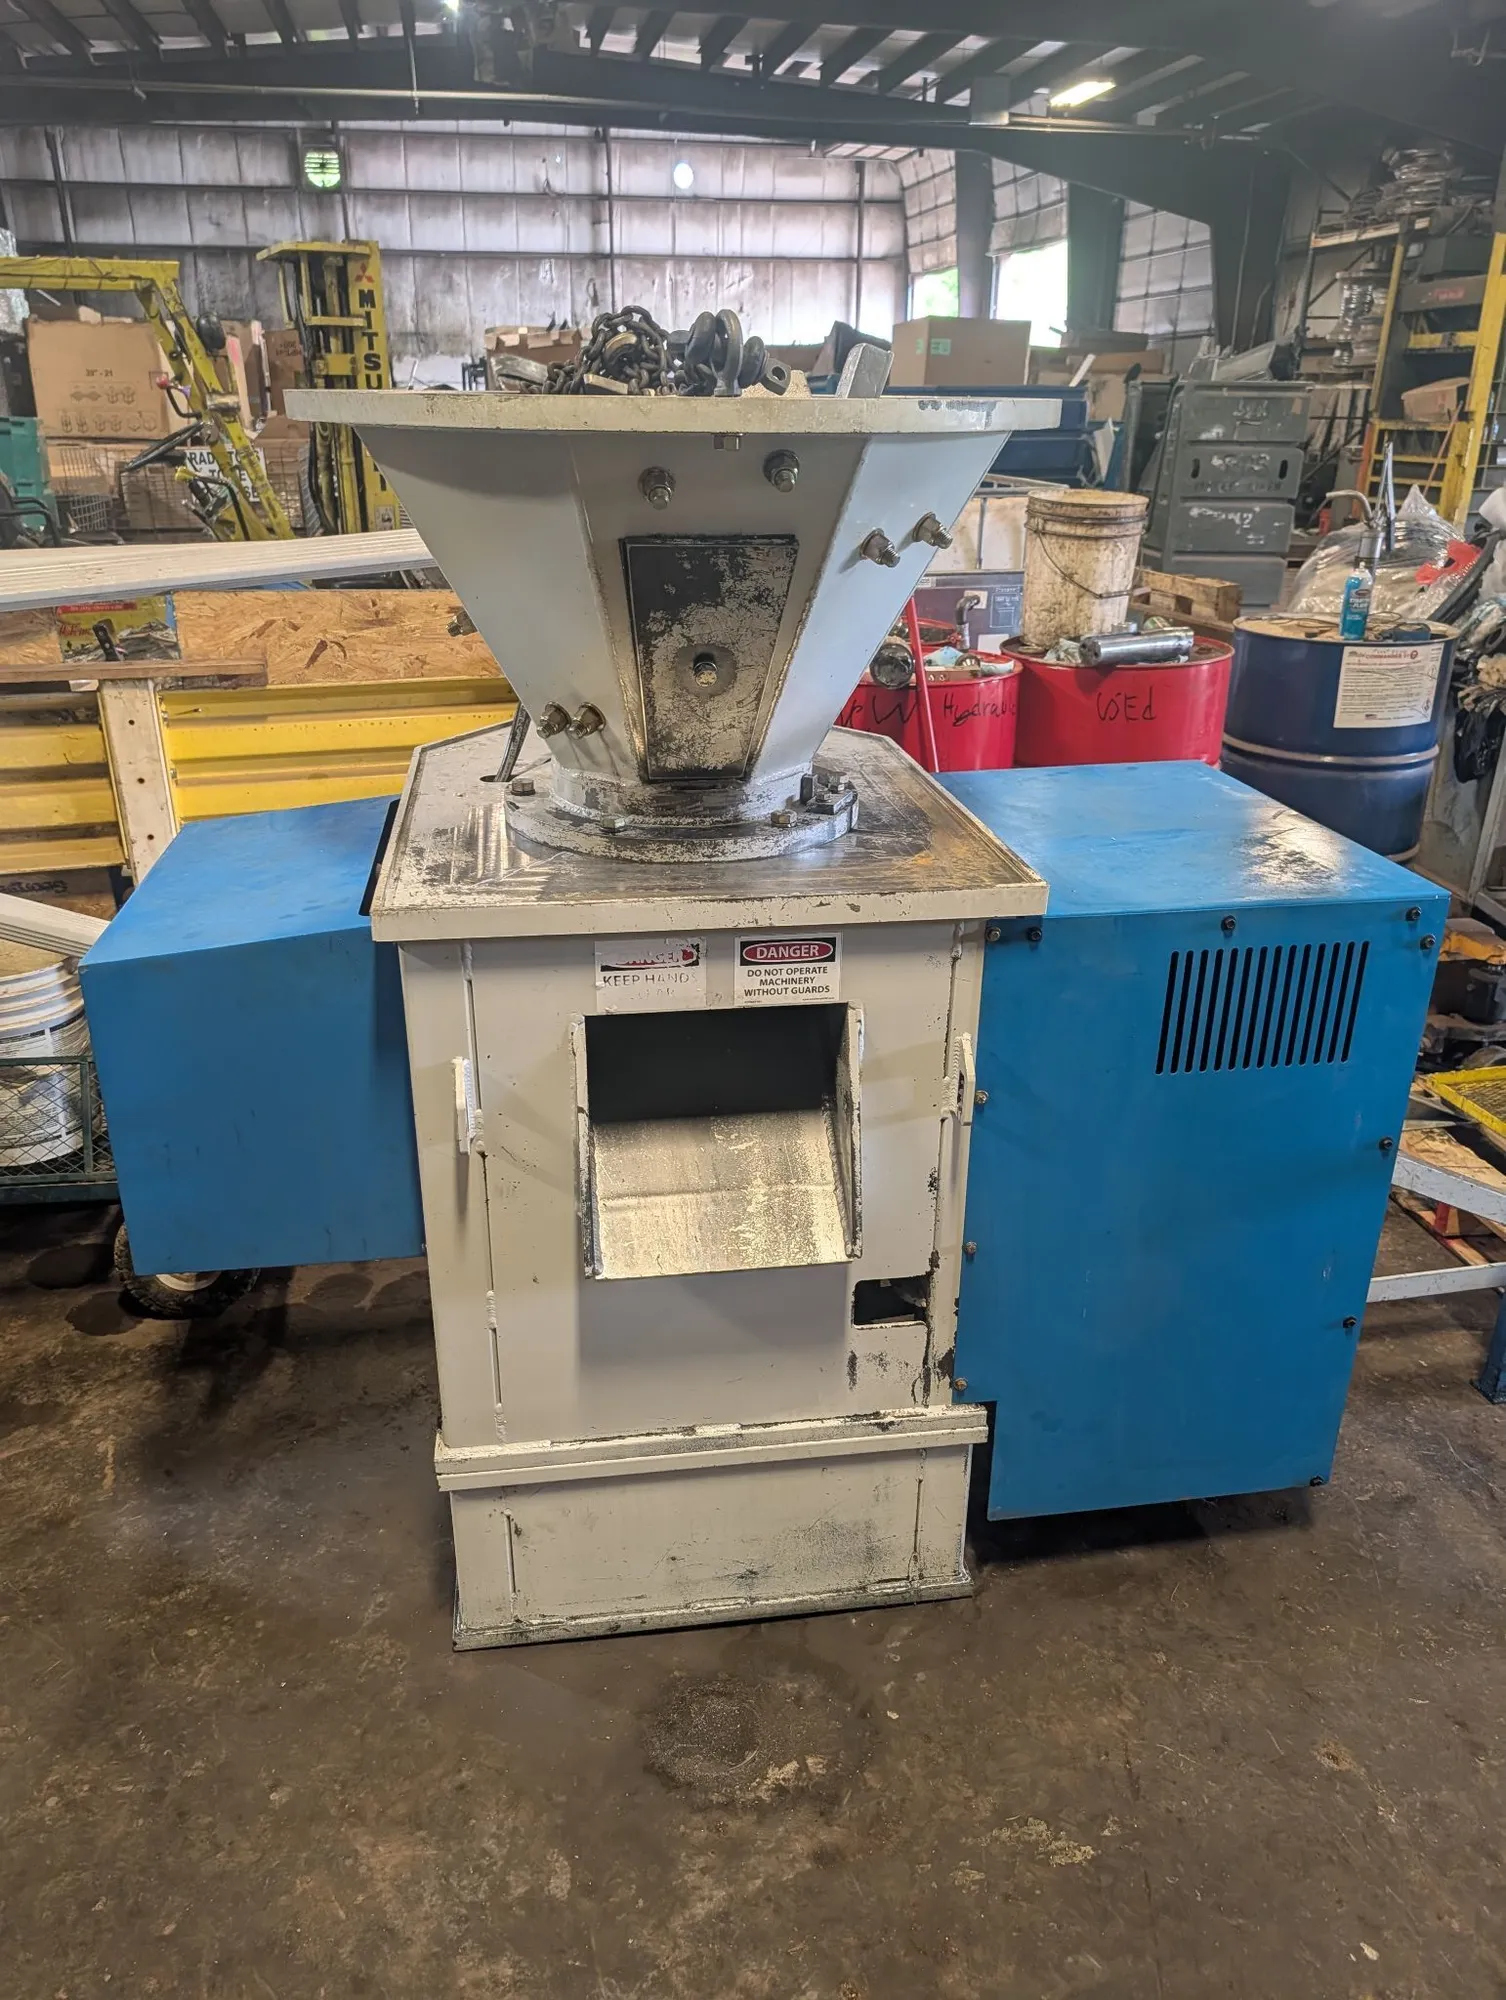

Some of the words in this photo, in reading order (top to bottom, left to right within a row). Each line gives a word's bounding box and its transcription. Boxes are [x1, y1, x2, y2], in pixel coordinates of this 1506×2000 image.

[756, 945, 819, 959] DANGER
[747, 969, 762, 977] DO
[764, 968, 784, 977] NOT
[786, 966, 828, 976] OPERATE
[603, 975, 640, 987] KEEP
[760, 976, 816, 986] MACHINERY
[744, 987, 789, 997] WITHOUT
[791, 985, 830, 995] GUARDS
